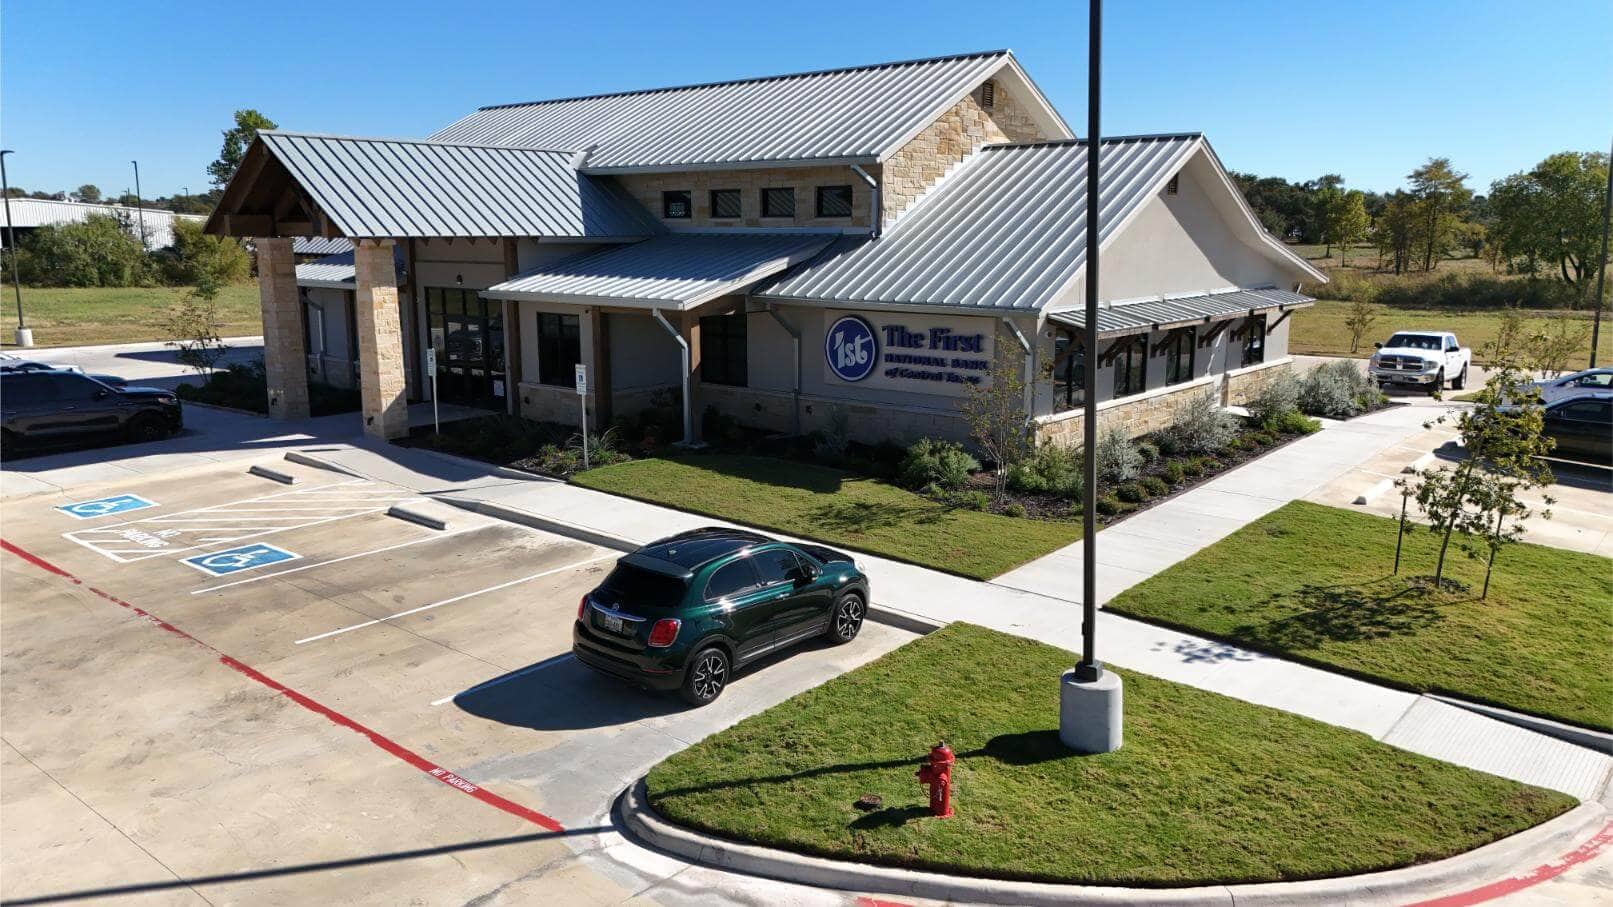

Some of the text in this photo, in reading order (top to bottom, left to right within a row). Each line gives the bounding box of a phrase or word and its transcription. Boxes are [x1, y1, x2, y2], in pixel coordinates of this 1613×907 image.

[834, 331, 872, 369] 1st
[882, 326, 984, 352] The First
[884, 353, 988, 370] NATIONAL BANK
[884, 367, 898, 378] of
[900, 369, 943, 382] Central
[429, 767, 478, 793] NO PARKING
